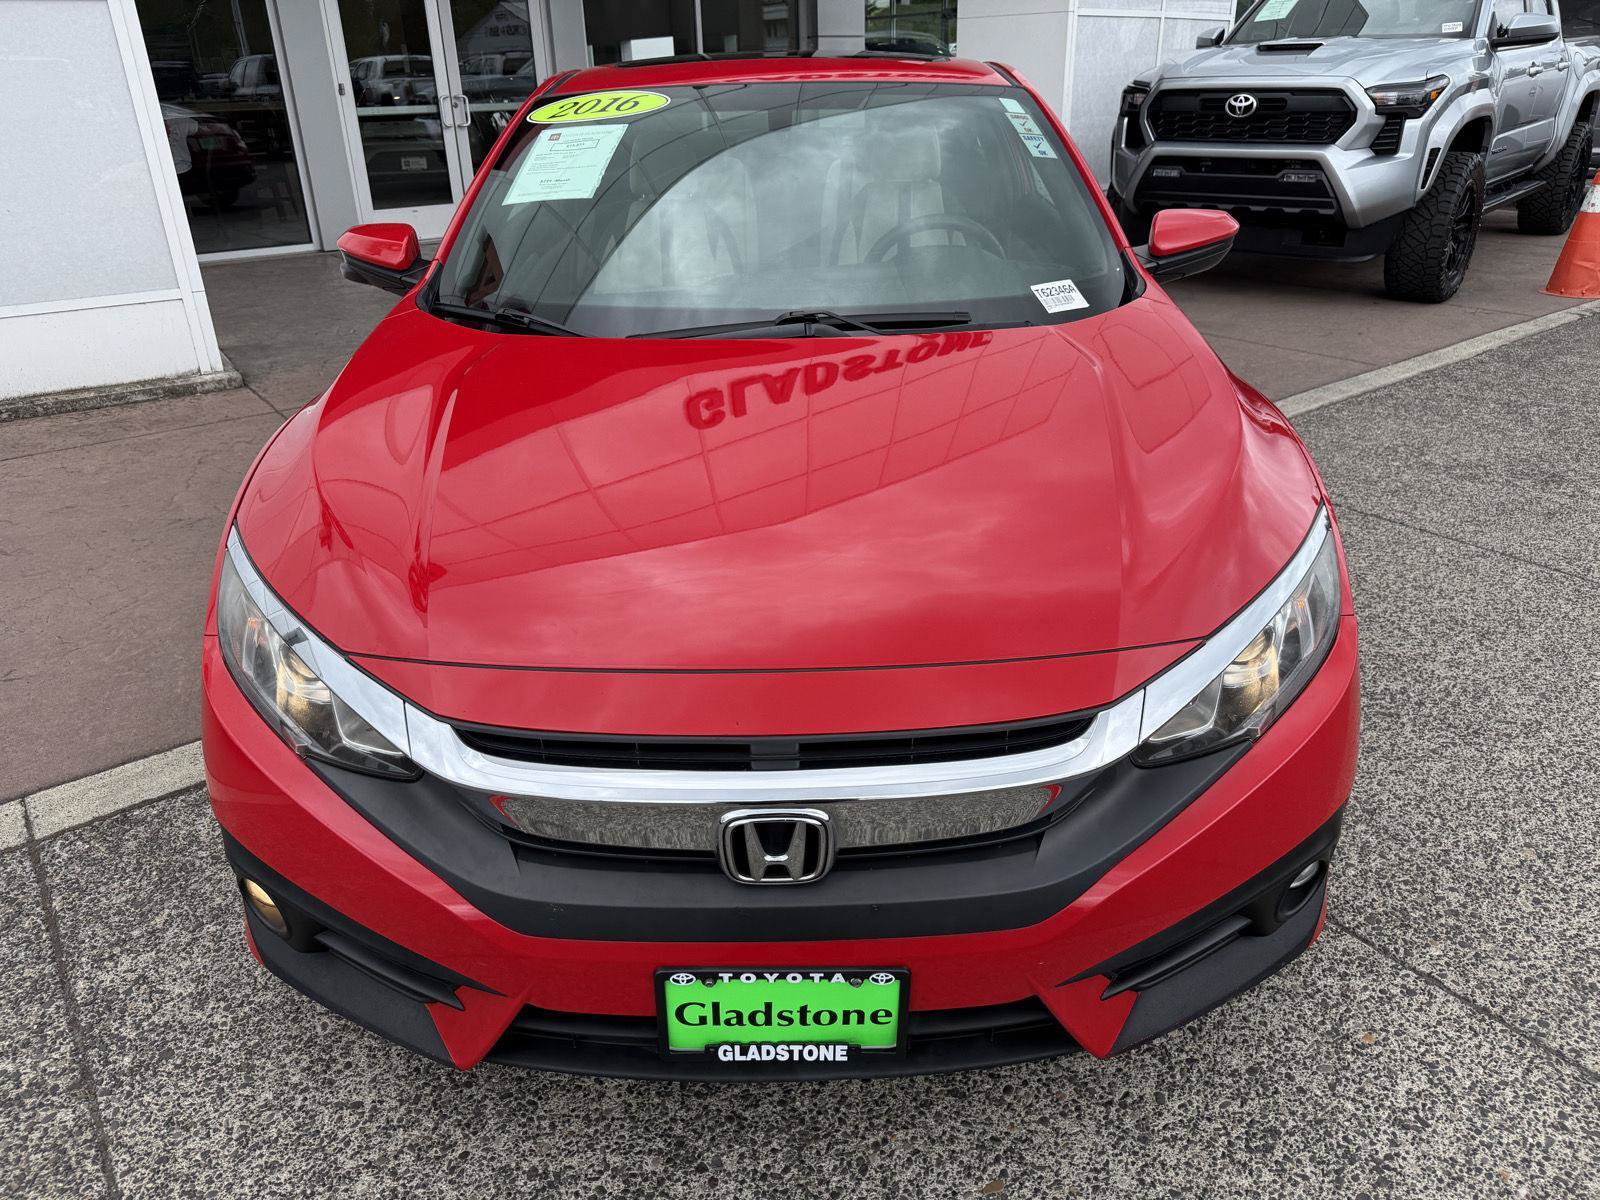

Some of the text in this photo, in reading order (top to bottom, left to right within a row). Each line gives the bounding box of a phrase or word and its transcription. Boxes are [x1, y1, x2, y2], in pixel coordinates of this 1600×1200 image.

[547, 94, 650, 120] 2016
[1034, 284, 1077, 299] T62346A
[718, 972, 848, 984] TOYOTA
[675, 1001, 893, 1027] Gladstone
[717, 1044, 848, 1062] GLADSTONE
